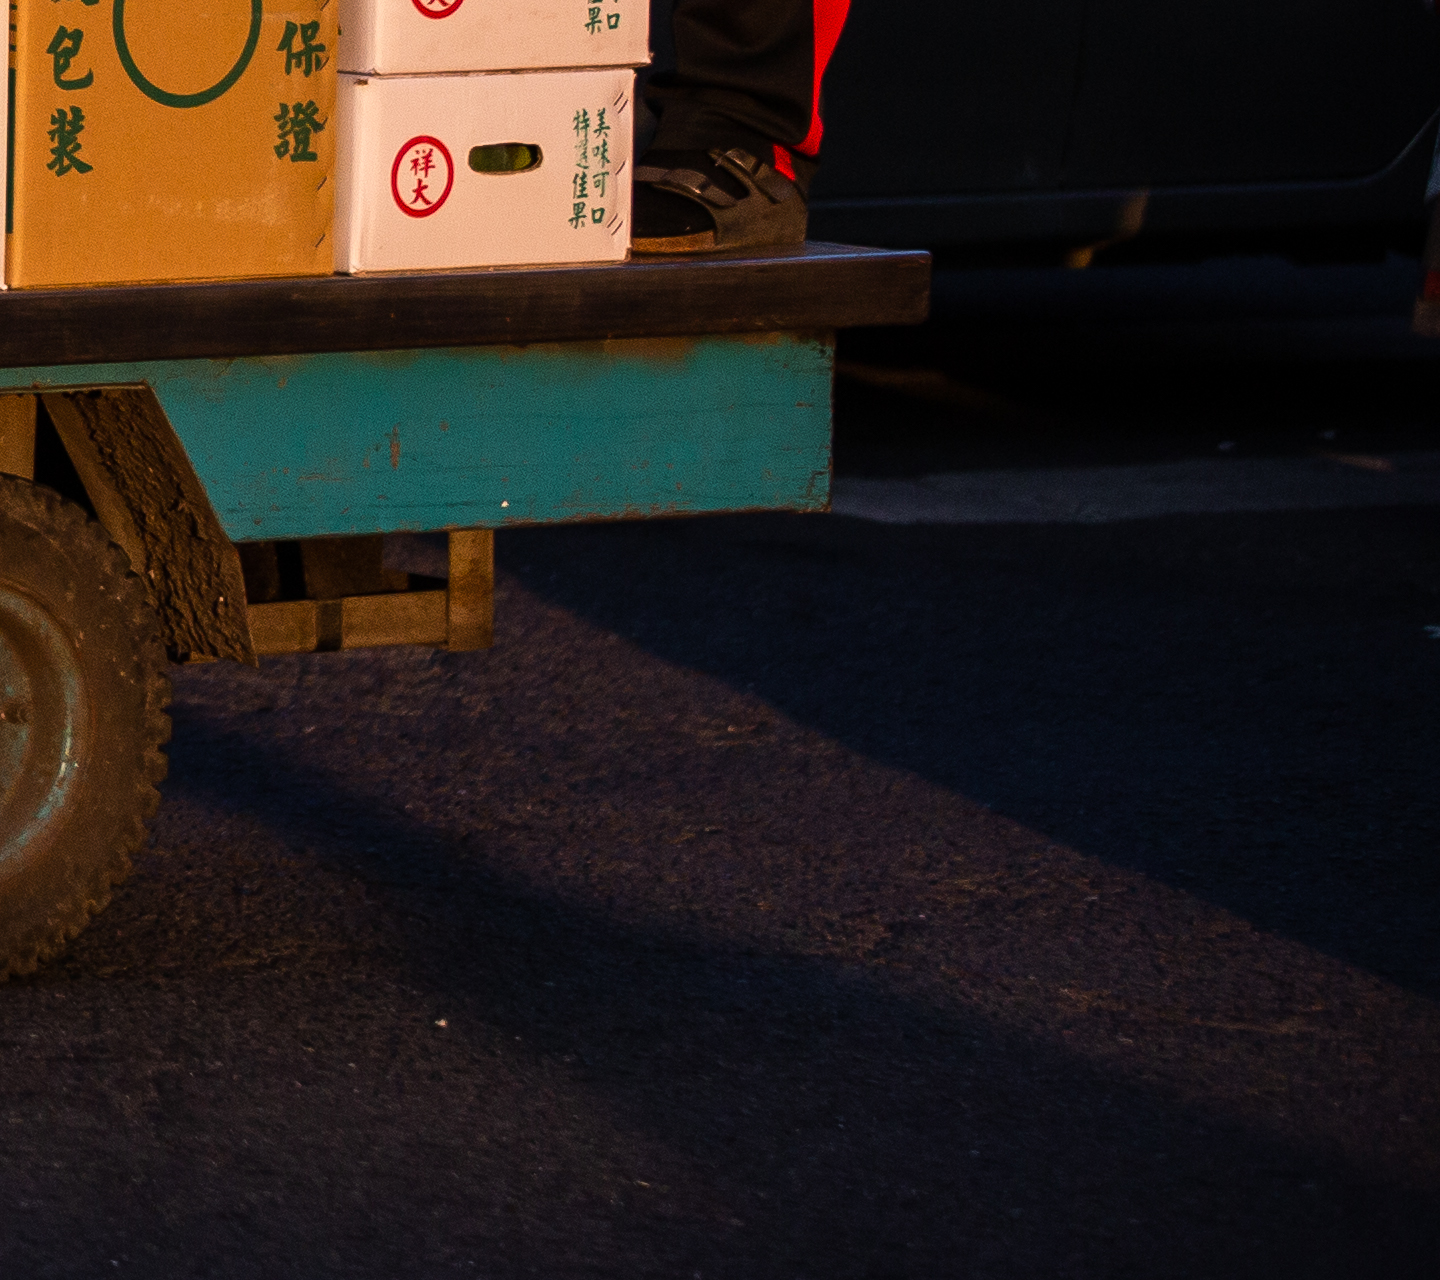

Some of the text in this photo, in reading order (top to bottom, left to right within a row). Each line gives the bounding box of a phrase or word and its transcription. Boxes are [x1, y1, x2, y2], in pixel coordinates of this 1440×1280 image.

[409, 148, 436, 208] 祥大
[589, 106, 611, 225] 美味可口
